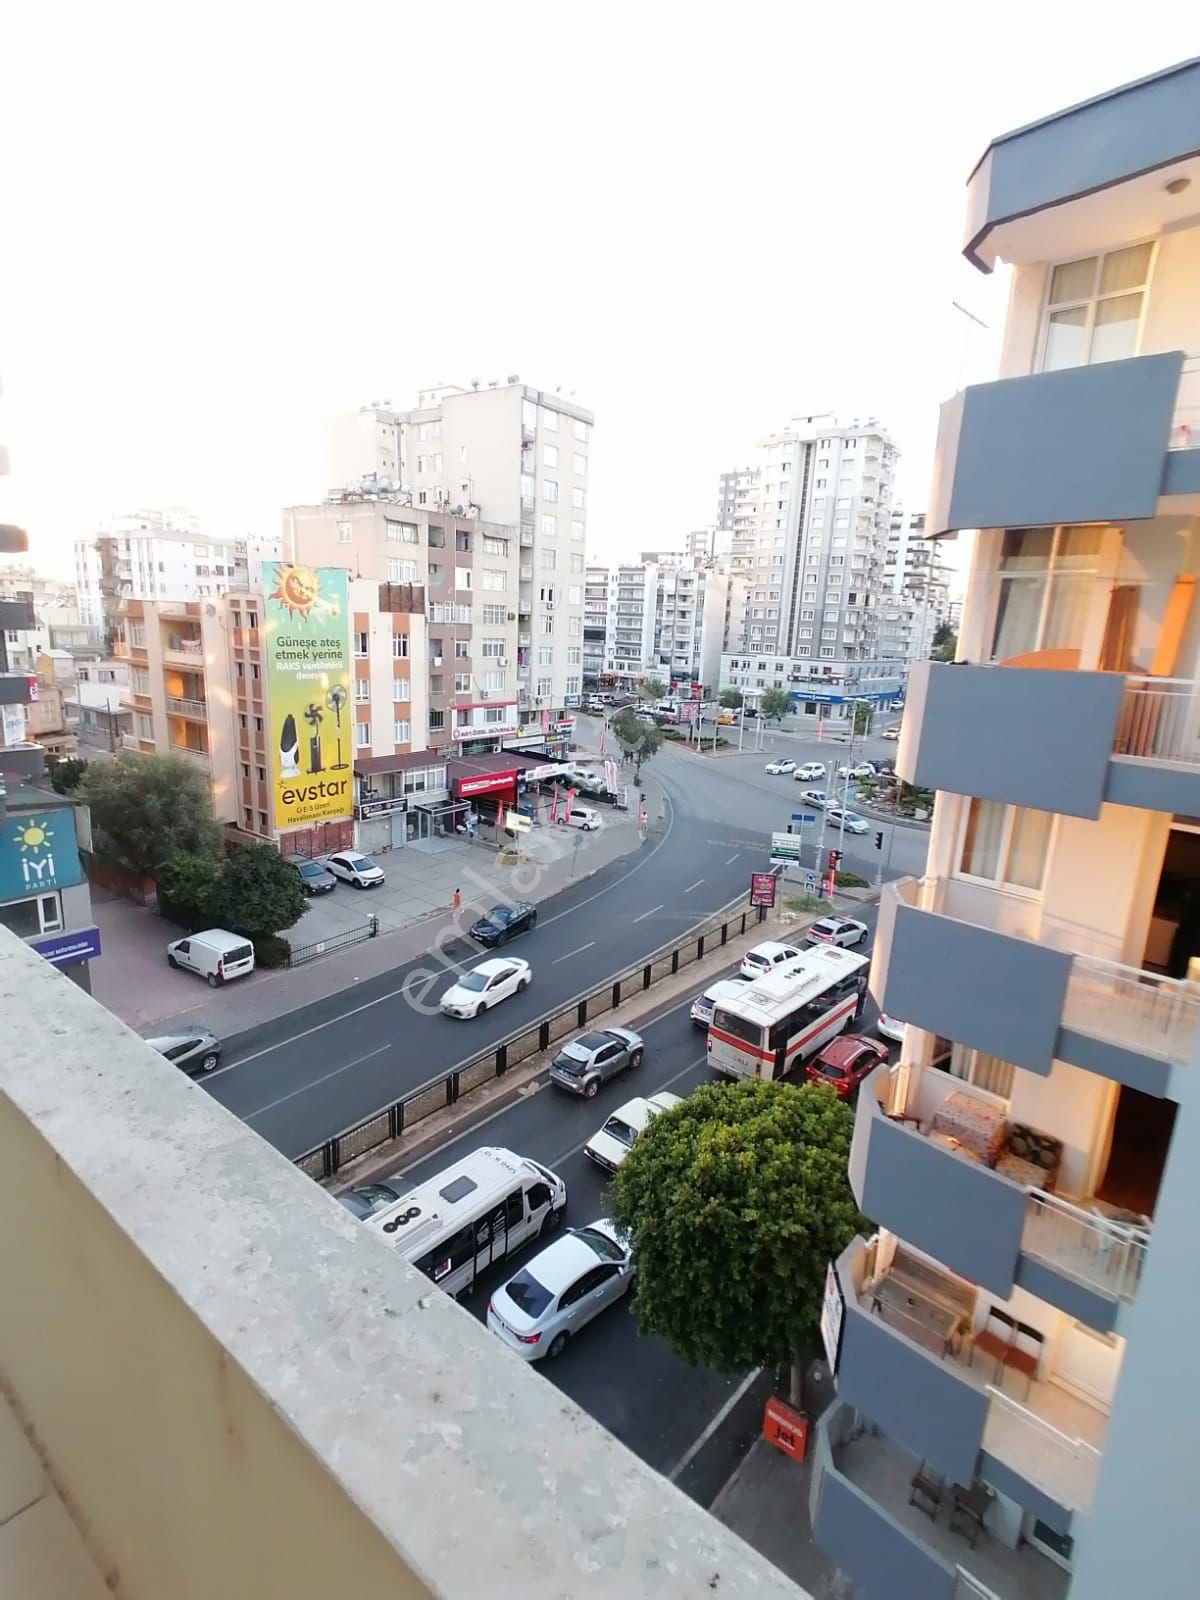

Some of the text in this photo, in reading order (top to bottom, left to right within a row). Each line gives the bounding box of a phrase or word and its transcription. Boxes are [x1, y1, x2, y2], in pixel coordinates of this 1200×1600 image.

[276, 636, 341, 649] Güneşe ateş
[275, 649, 343, 661] etmek yerine
[276, 662, 300, 671] RAKS
[282, 780, 347, 805] evstar
[22, 853, 55, 882] İYİ
[26, 879, 57, 890] PARTİ
